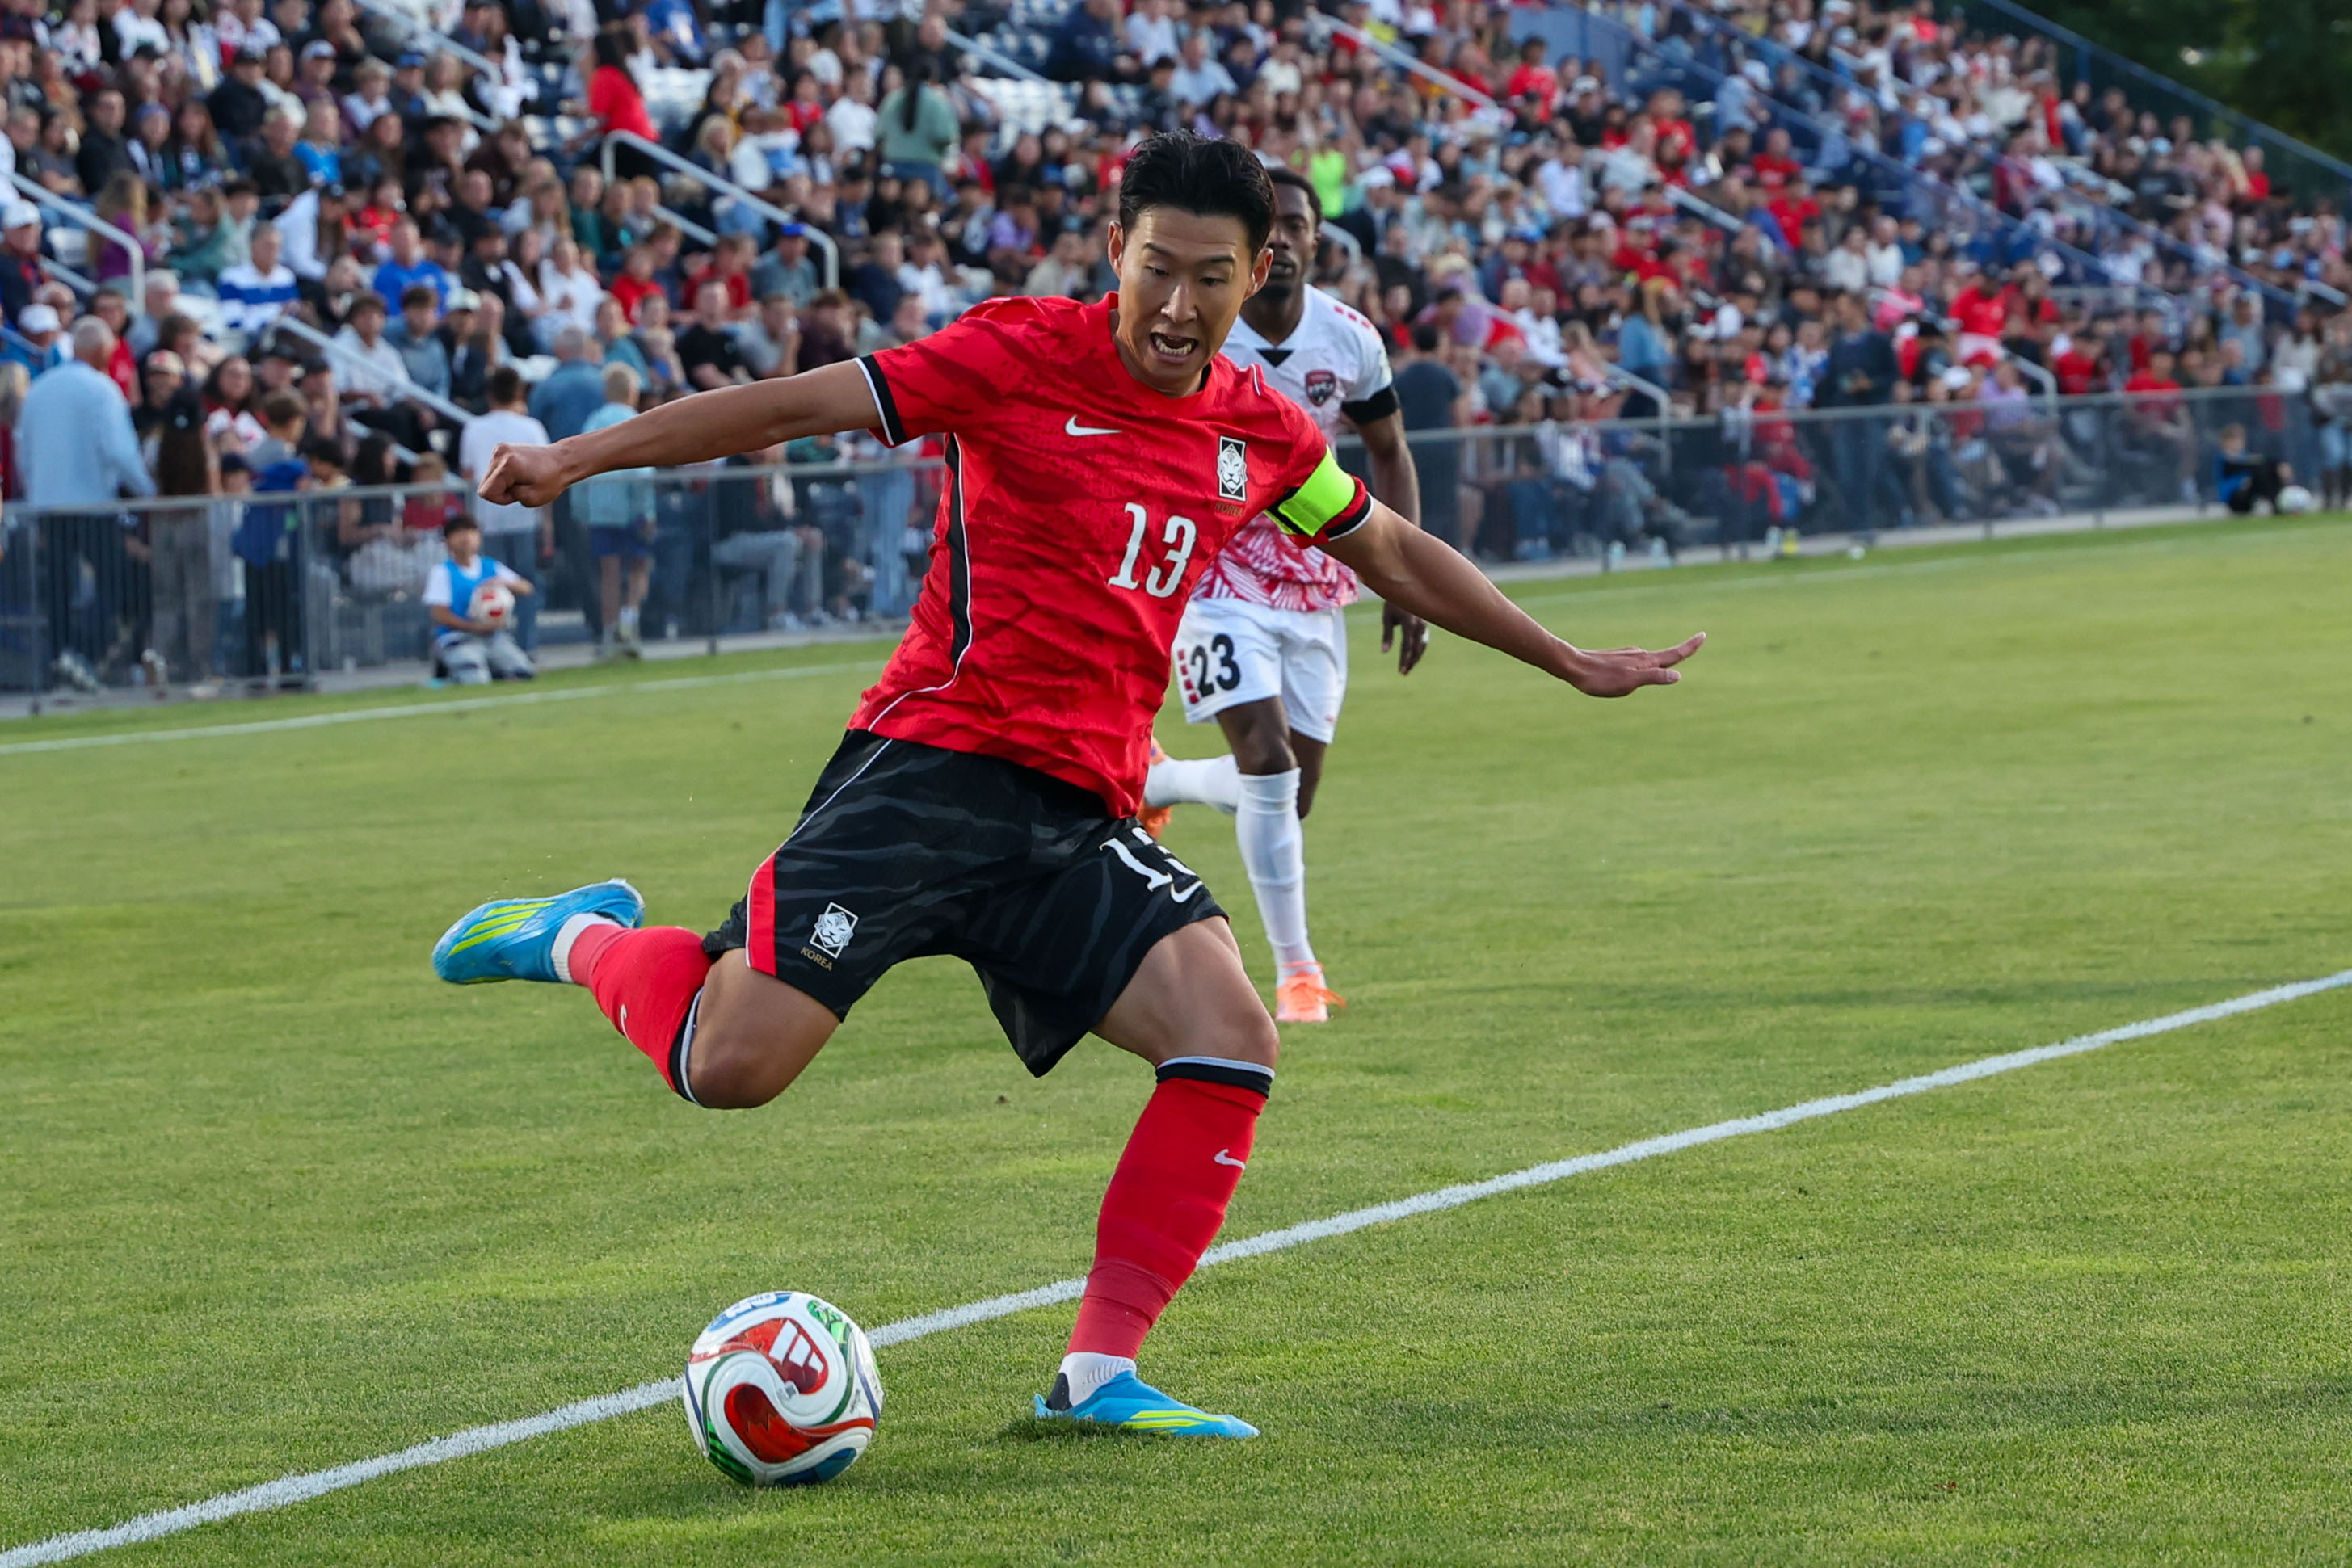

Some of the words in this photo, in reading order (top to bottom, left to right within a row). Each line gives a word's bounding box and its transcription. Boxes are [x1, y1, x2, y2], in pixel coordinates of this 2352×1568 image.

[1108, 502, 1197, 598] 13
[1190, 633, 1240, 697] 23
[800, 947, 833, 971] KOREA
